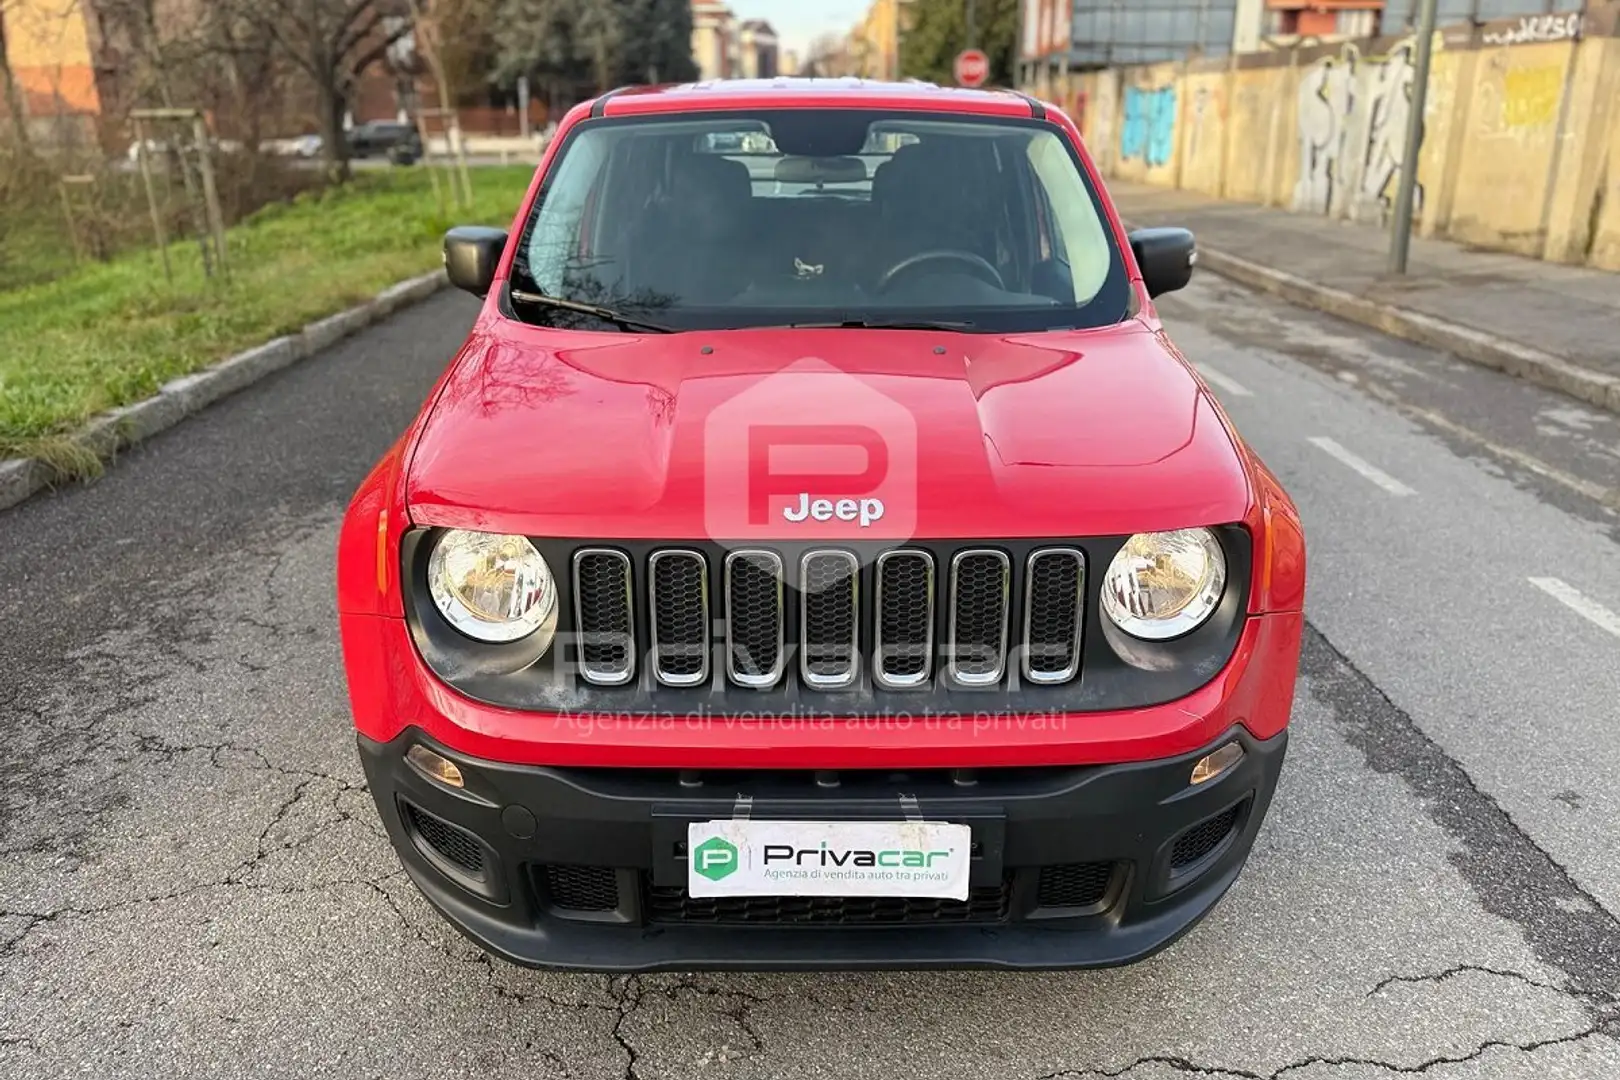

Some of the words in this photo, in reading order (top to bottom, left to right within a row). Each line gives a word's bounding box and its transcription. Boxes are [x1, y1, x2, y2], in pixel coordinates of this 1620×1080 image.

[783, 493, 884, 527] Jeep
[702, 849, 733, 870] P
[764, 841, 949, 867] Privacar
[764, 868, 808, 879] Agenzia
[810, 868, 821, 879] di
[824, 868, 865, 880] vendita
[867, 871, 893, 880] auto
[896, 871, 910, 880] tra
[914, 871, 948, 881] privati
